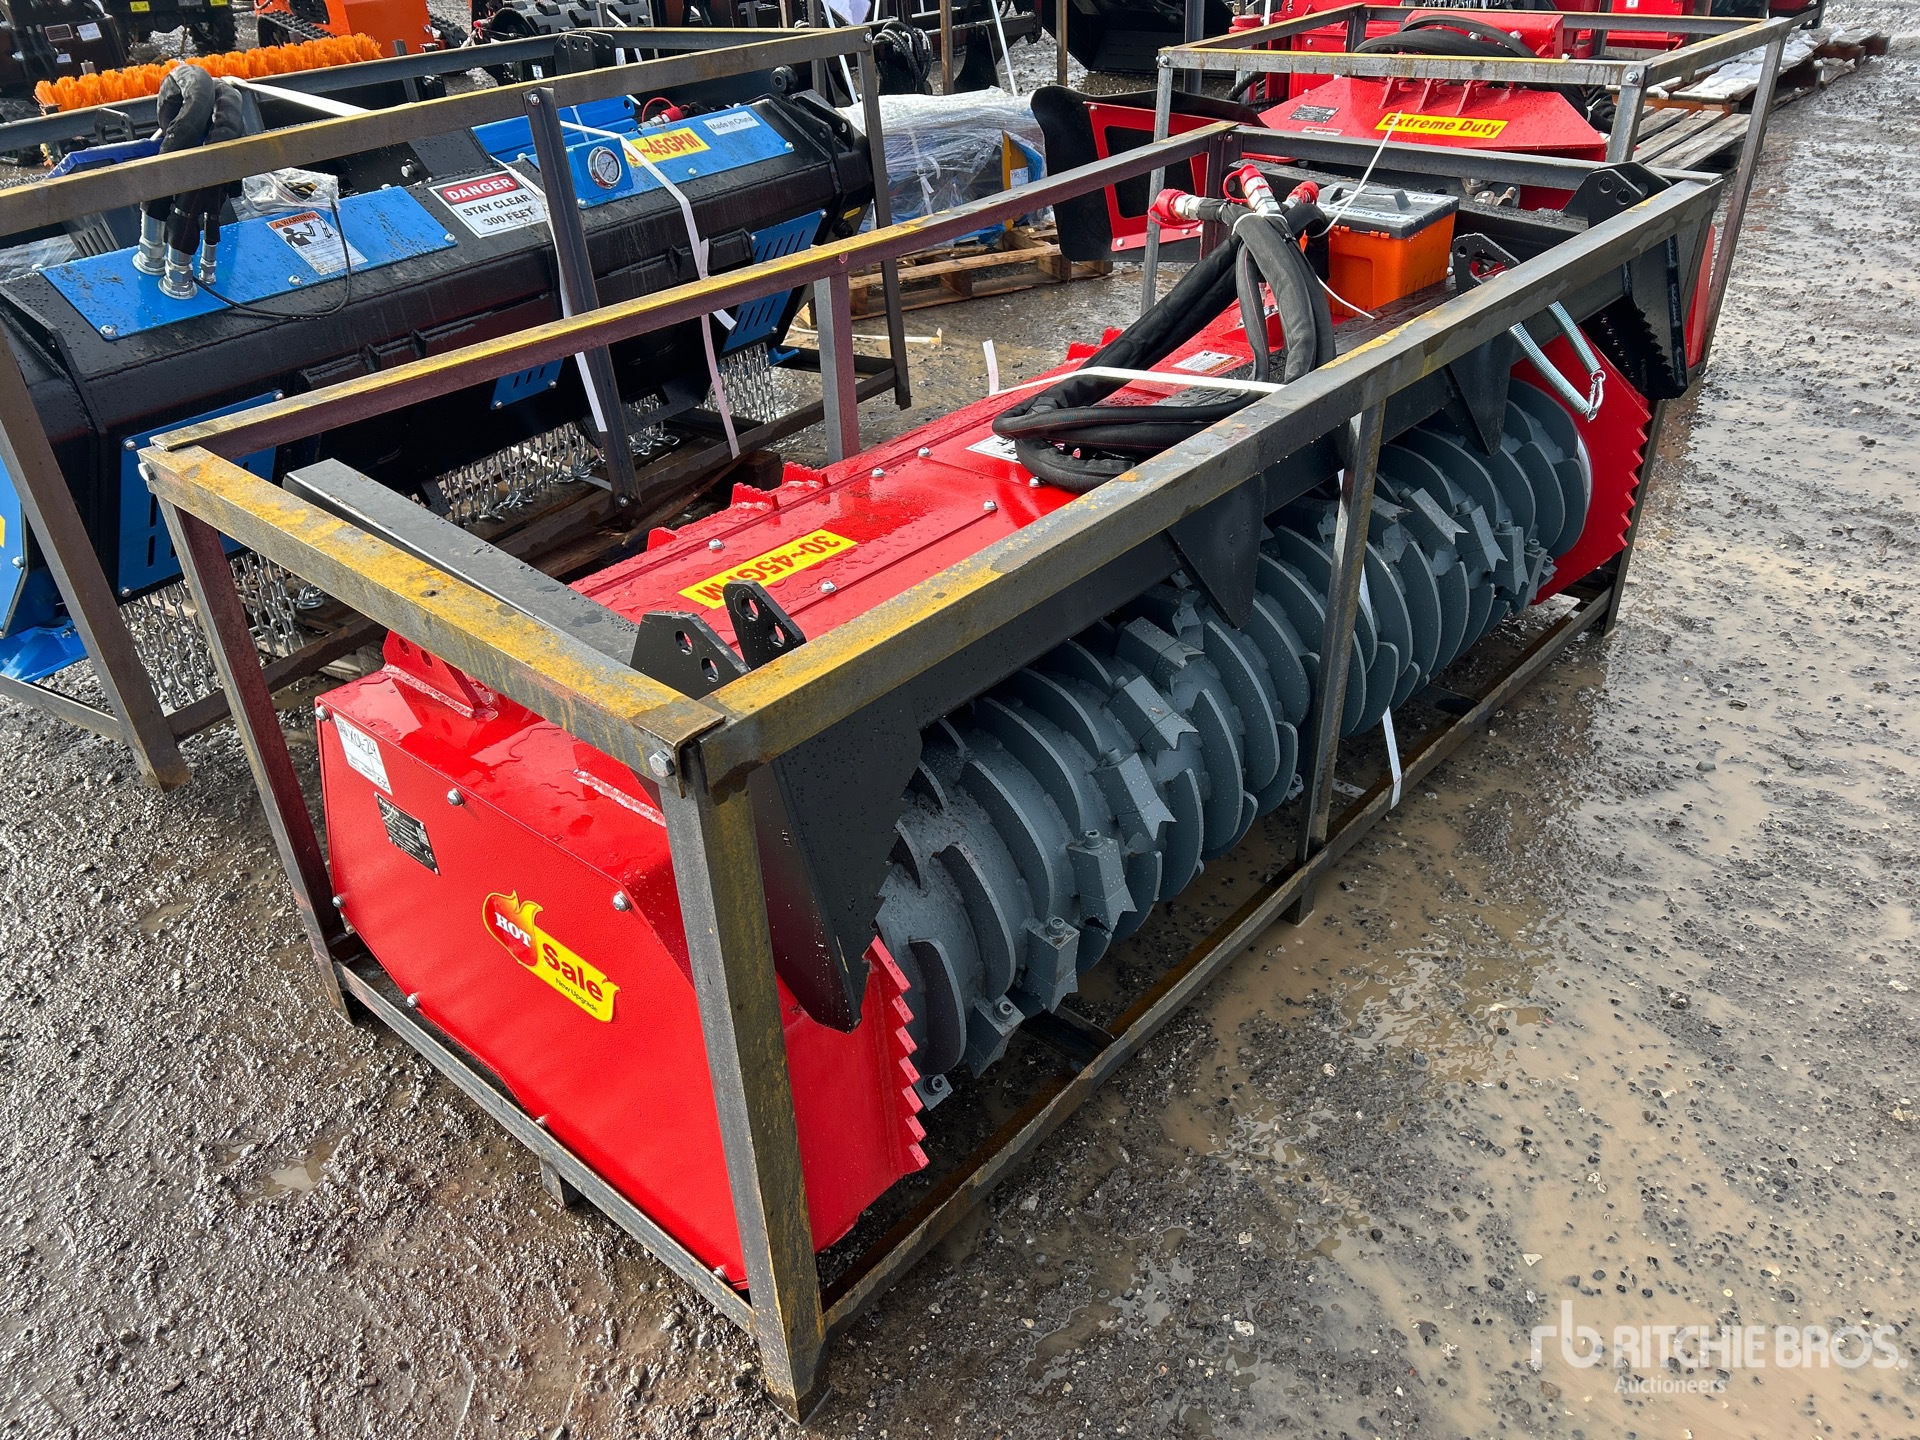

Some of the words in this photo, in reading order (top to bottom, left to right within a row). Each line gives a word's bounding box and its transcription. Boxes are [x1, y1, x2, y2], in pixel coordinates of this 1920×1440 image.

[709, 121, 729, 130] Made
[733, 116, 754, 125] China
[1383, 115, 1456, 132] Extreme
[1458, 120, 1503, 136] Duty
[446, 178, 515, 201] DANGER
[462, 203, 493, 217] STAY
[494, 194, 532, 209] CLEAR
[483, 214, 506, 226] 300
[506, 206, 535, 220] FEET
[695, 535, 841, 601] 30~45GM
[494, 911, 532, 948] HOT
[542, 942, 603, 1002] Sale
